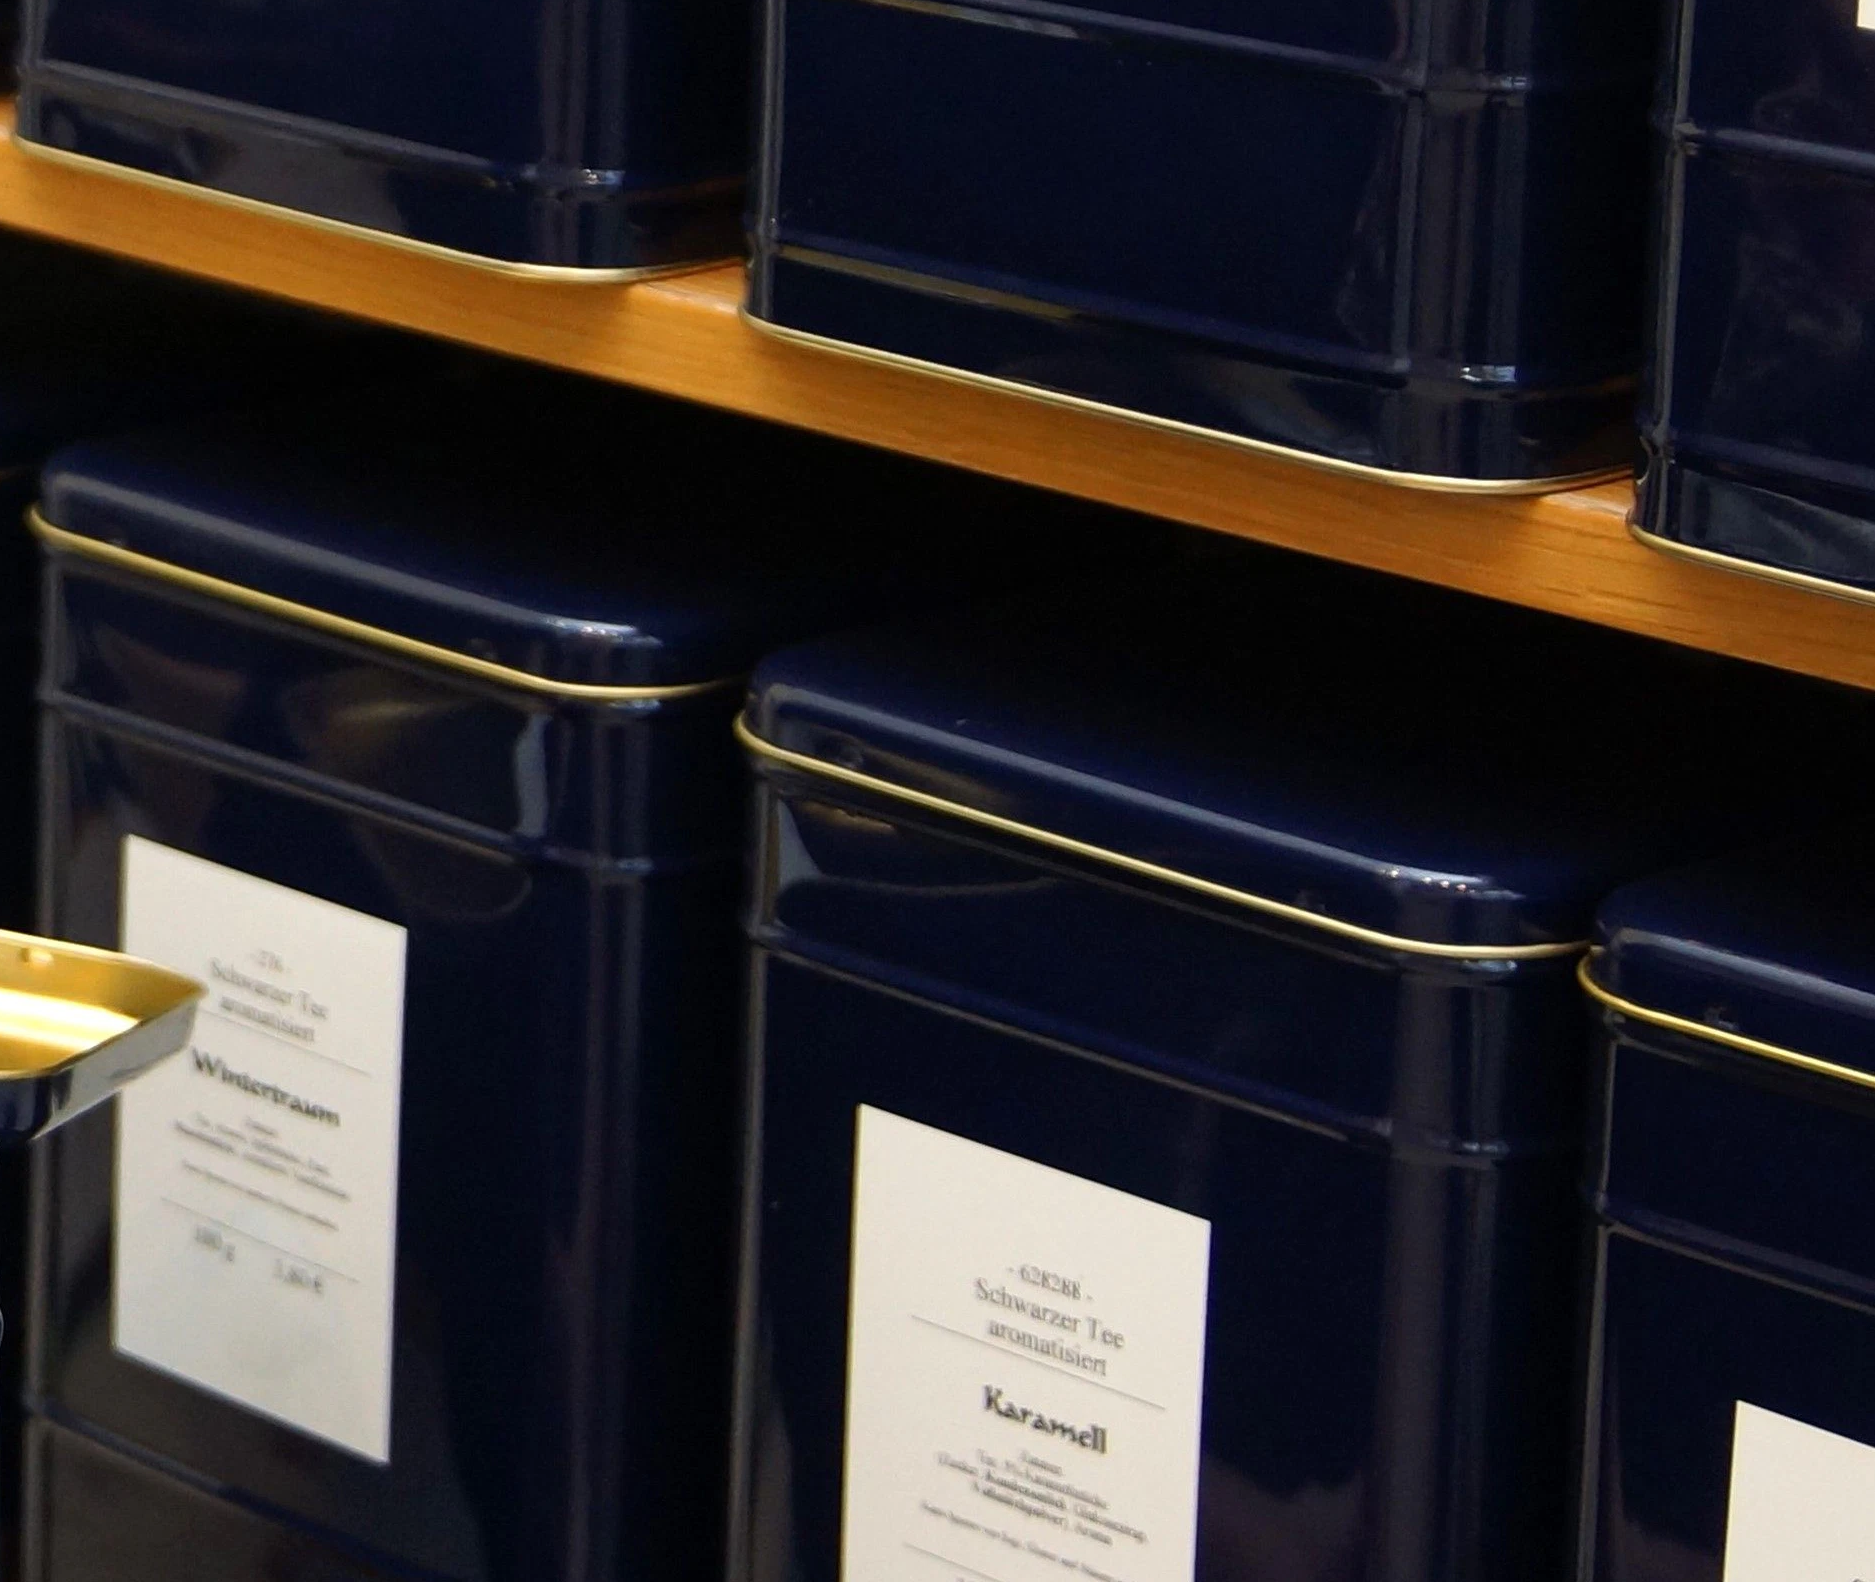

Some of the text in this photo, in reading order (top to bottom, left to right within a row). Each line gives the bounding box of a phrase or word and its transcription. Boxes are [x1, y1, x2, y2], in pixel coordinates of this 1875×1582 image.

[974, 1277, 1125, 1350] Schwarzer Tee
[987, 1320, 1108, 1377] aromatisiert
[982, 1384, 1108, 1455] Karamell
